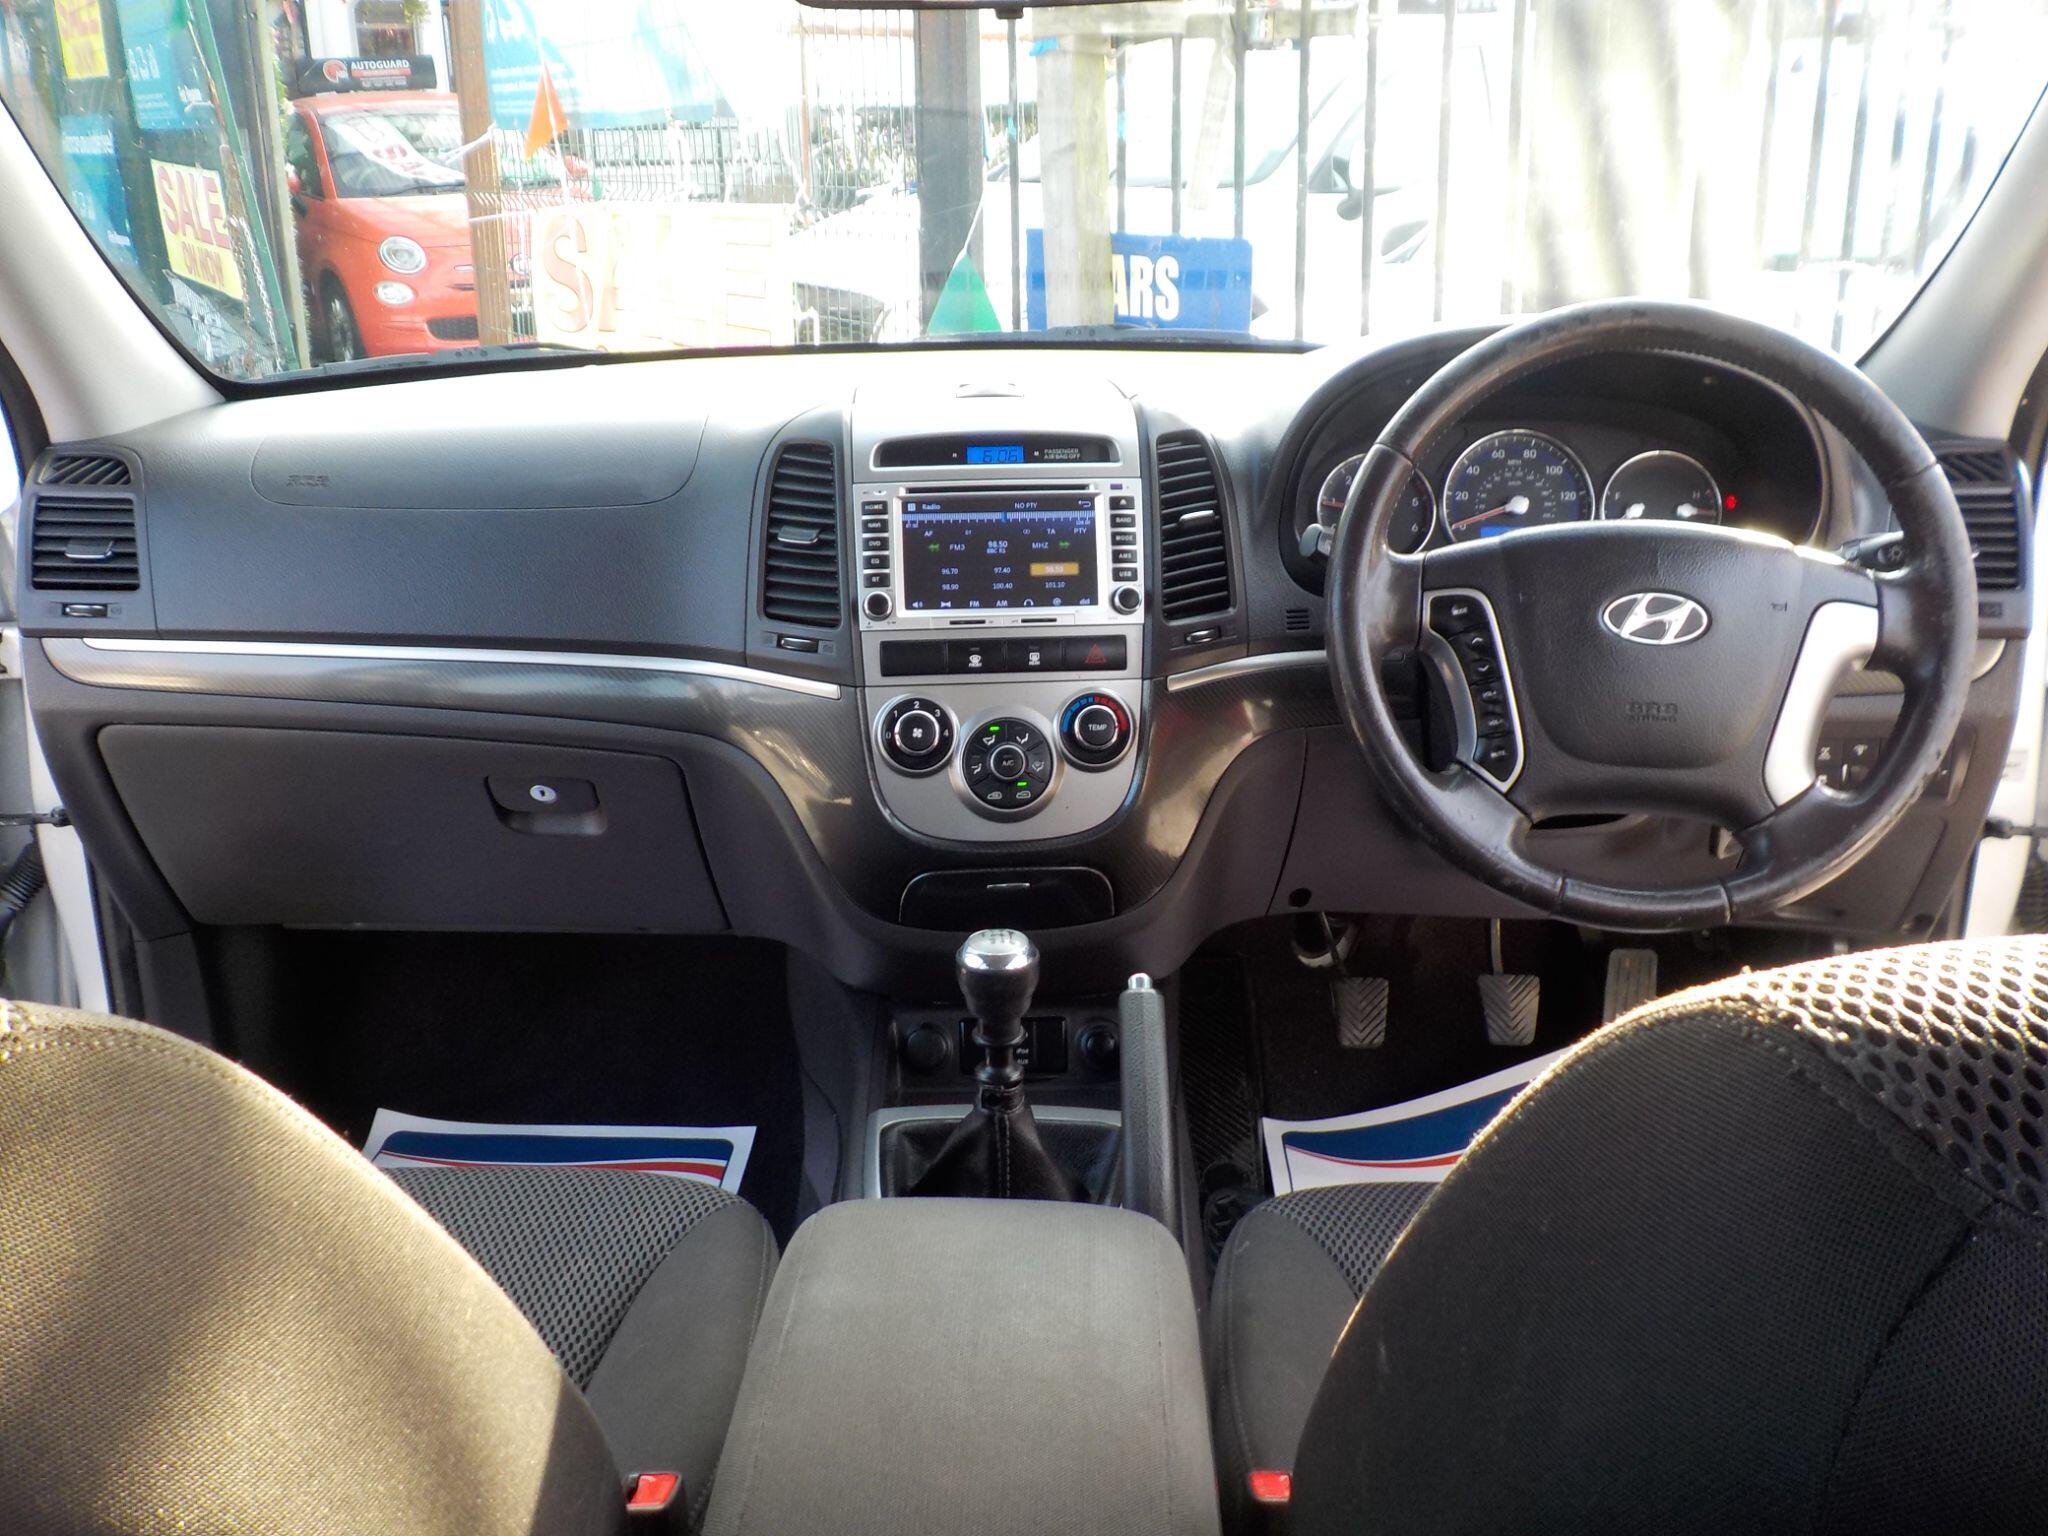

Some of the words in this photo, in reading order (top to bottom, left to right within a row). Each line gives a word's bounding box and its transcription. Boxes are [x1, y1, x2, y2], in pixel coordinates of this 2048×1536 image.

[351, 59, 410, 70] AUTOGUARD
[156, 165, 232, 250] SALE
[1112, 254, 1180, 321] ARS
[1491, 450, 1505, 459] 60
[1523, 449, 1537, 459] 80
[1466, 465, 1480, 475] 40
[1545, 465, 1563, 475] 100
[1345, 475, 1353, 486] 2
[1455, 491, 1469, 500] 20
[1560, 491, 1577, 500] 120
[1073, 527, 1087, 535] PTY
[1412, 523, 1419, 532] 6
[949, 543, 966, 551] FM3
[1031, 541, 1049, 549] MHZ
[941, 567, 959, 575] 96.70
[993, 566, 1011, 574] 97.40
[992, 582, 1013, 590] 100.40
[913, 700, 920, 709] 2
[893, 710, 898, 718] 1
[934, 709, 941, 718] 3
[885, 731, 892, 740] 0
[943, 728, 950, 737] 4
[1001, 759, 1014, 767] A/C
